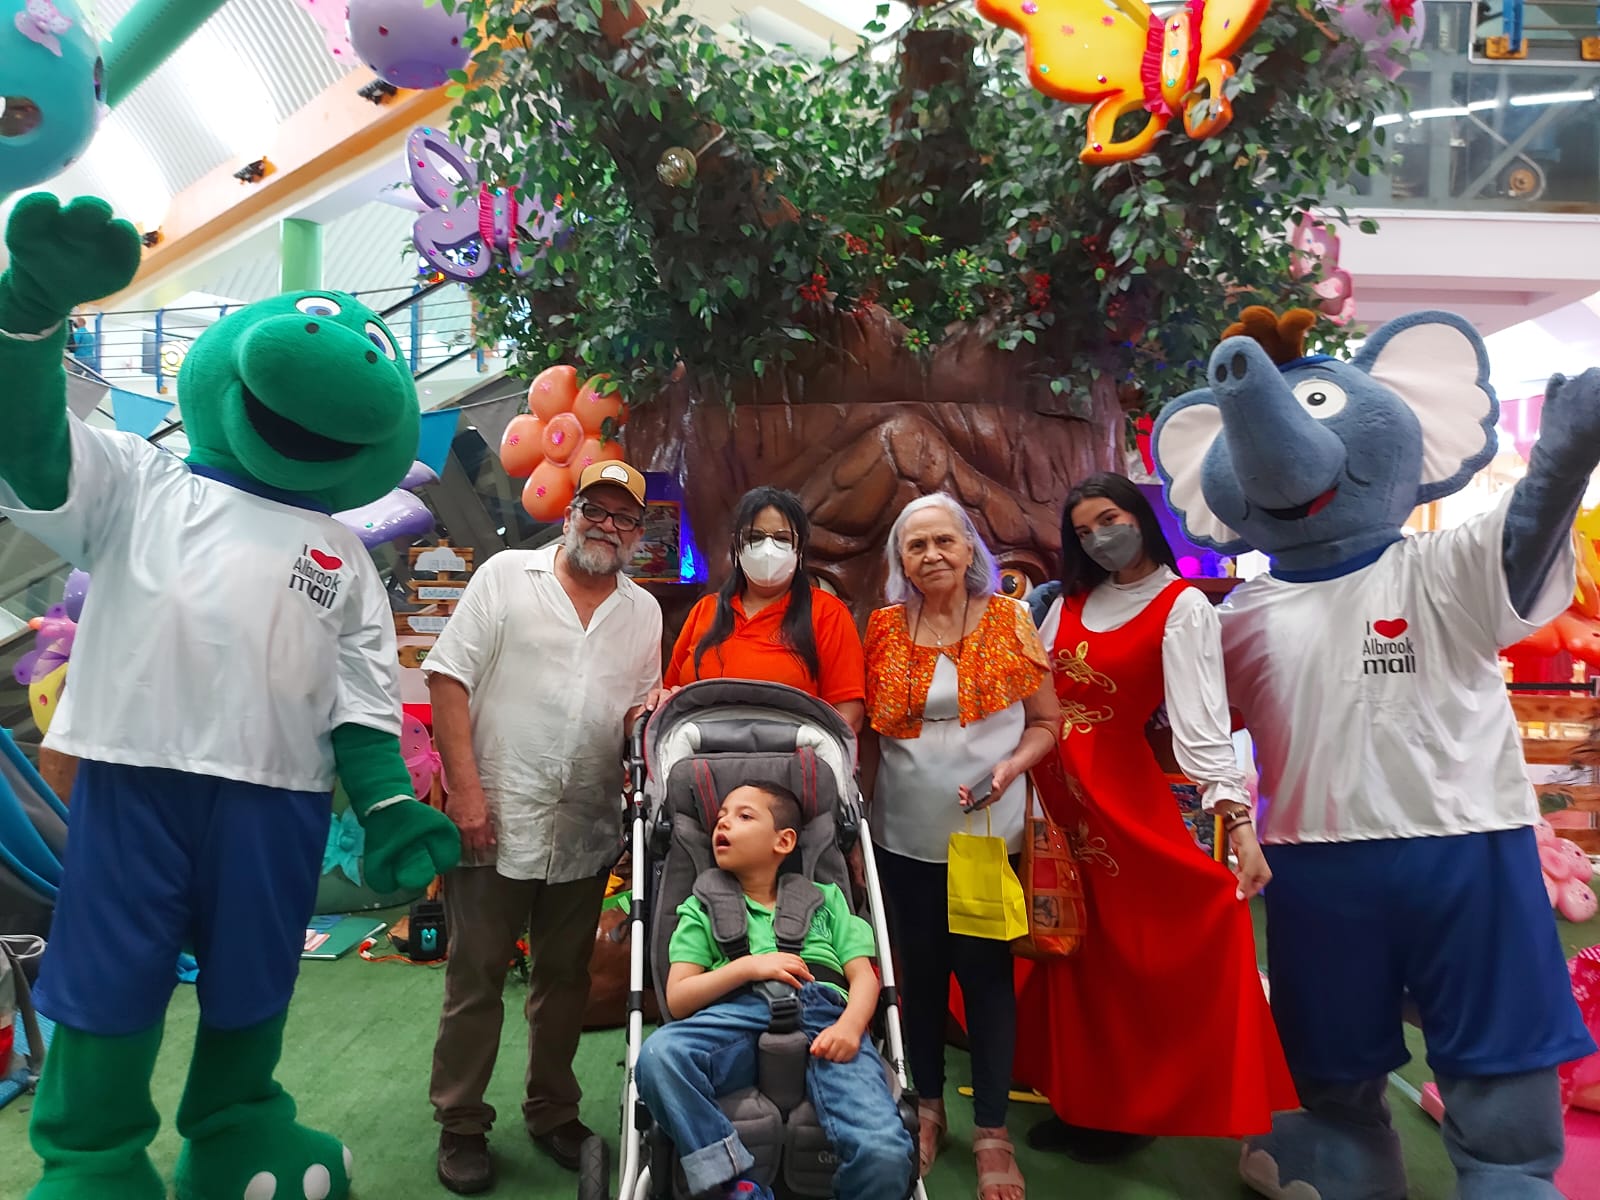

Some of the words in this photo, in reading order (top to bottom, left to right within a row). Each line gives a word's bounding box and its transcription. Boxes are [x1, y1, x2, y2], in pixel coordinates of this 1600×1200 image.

[303, 544, 308, 556] I
[293, 557, 341, 592] Albrook
[289, 573, 336, 609] mall
[1366, 621, 1370, 635] I
[1363, 637, 1414, 657] Albrook
[1364, 655, 1416, 674] mall
